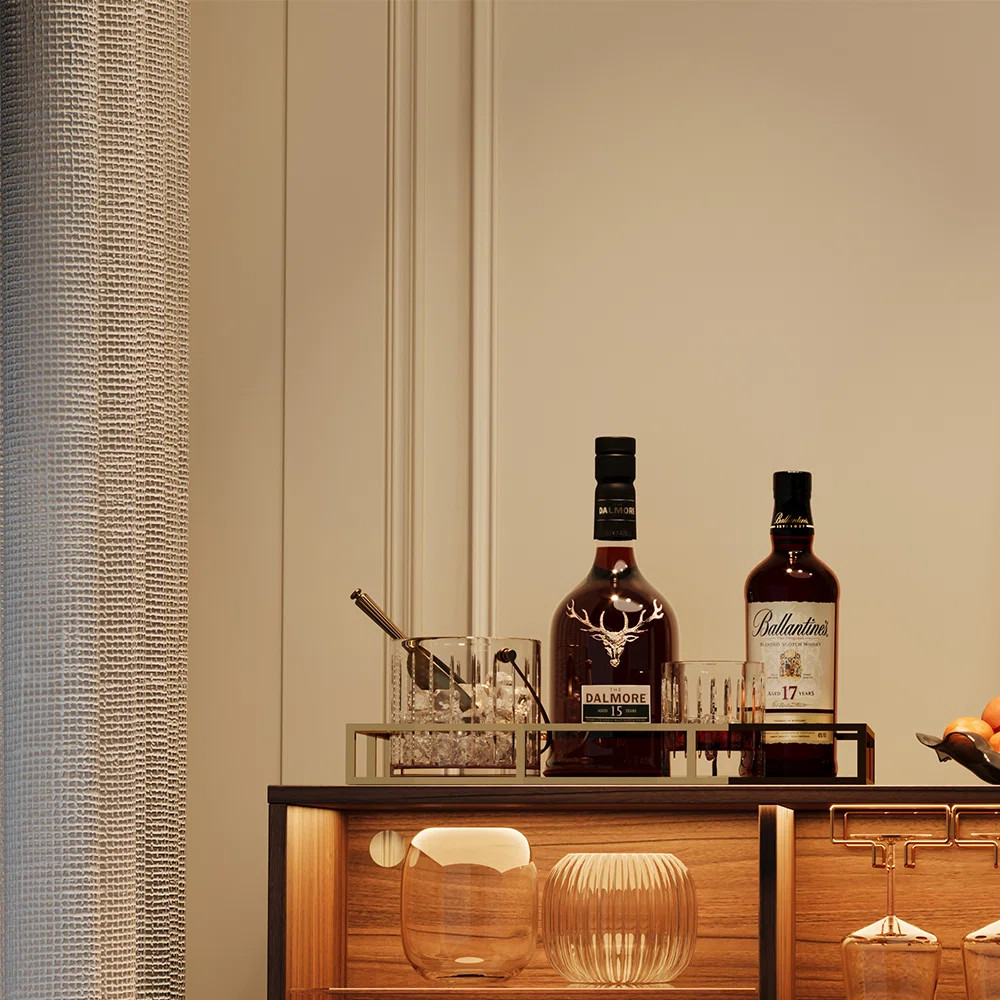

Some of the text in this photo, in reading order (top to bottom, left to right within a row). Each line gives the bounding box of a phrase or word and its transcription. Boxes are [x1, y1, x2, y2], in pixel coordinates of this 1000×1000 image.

[752, 608, 829, 637] Ballantine's
[585, 693, 647, 704] DALMORE
[782, 685, 798, 701] 17
[611, 705, 623, 717] 15
